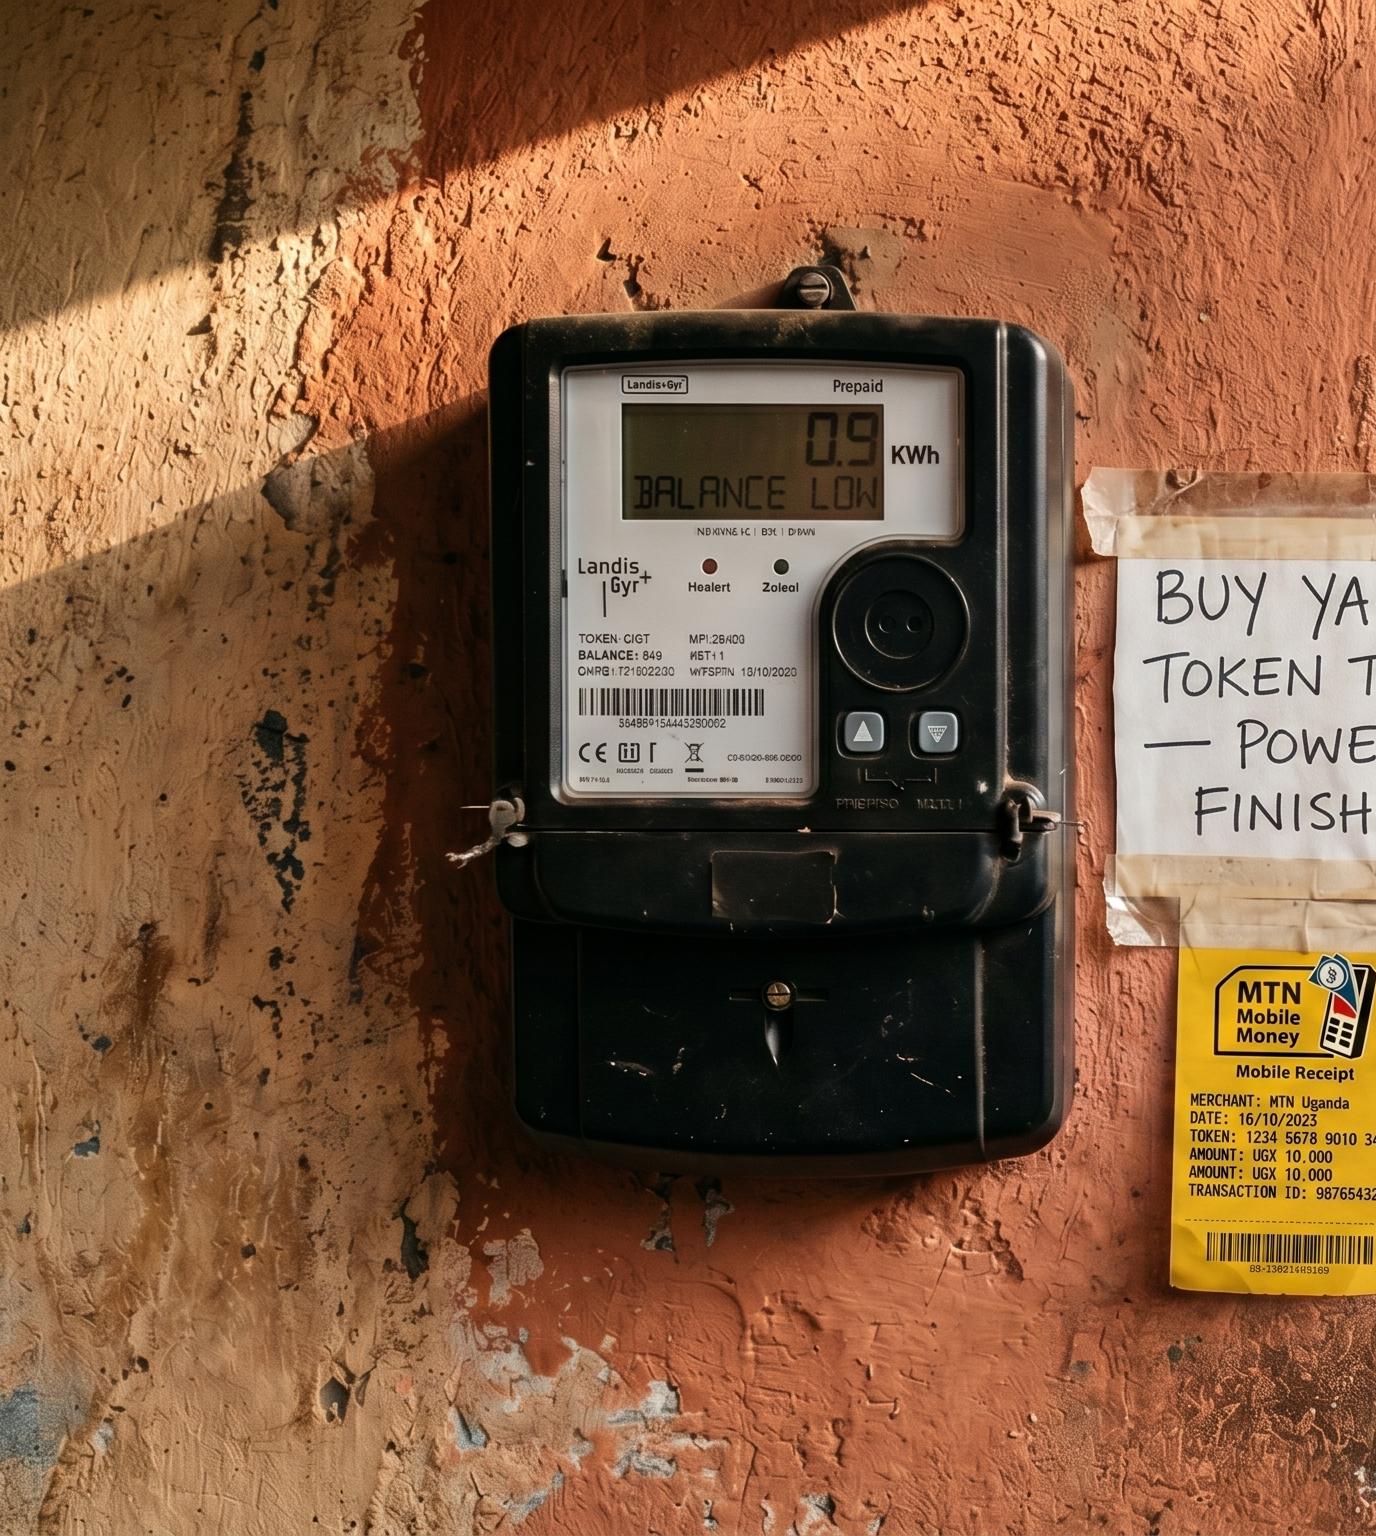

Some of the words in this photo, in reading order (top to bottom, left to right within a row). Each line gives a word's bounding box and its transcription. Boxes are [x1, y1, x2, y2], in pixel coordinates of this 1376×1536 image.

[833, 379, 883, 395] Prepaid
[805, 411, 879, 467] 0.9
[891, 445, 940, 465] KWh
[634, 475, 786, 510] BALANCE
[811, 475, 878, 510] LOW
[1156, 569, 1267, 636] BUY
[578, 650, 639, 661] BALANCE:
[643, 650, 662, 660] 849
[1142, 652, 1321, 703] TOKEN
[1237, 981, 1301, 1005] MTN
[1236, 1008, 1300, 1025] Mobile
[1236, 1028, 1300, 1048] Money
[1236, 1065, 1290, 1079] Mobile
[1295, 1066, 1355, 1083] Receipt
[1190, 1093, 1261, 1108] MERCHANT:
[1270, 1095, 1294, 1108] MTN
[1302, 1096, 1350, 1112] Uganda
[1190, 1111, 1229, 1125] DATE:
[1239, 1113, 1317, 1127] 16/10/2023
[1190, 1129, 1236, 1143] TOKEN:
[1247, 1131, 1277, 1144] 1234
[1285, 1132, 1317, 1145] 5678
[1325, 1132, 1357, 1146] 9010
[1189, 1148, 1244, 1162] AMOUNT:
[1253, 1149, 1277, 1162] UGX
[1189, 1166, 1244, 1180] AMOUNT:
[1252, 1167, 1276, 1180] UGX
[1189, 1184, 1276, 1199] TRANSACTION
[1285, 1186, 1306, 1199] ID:
